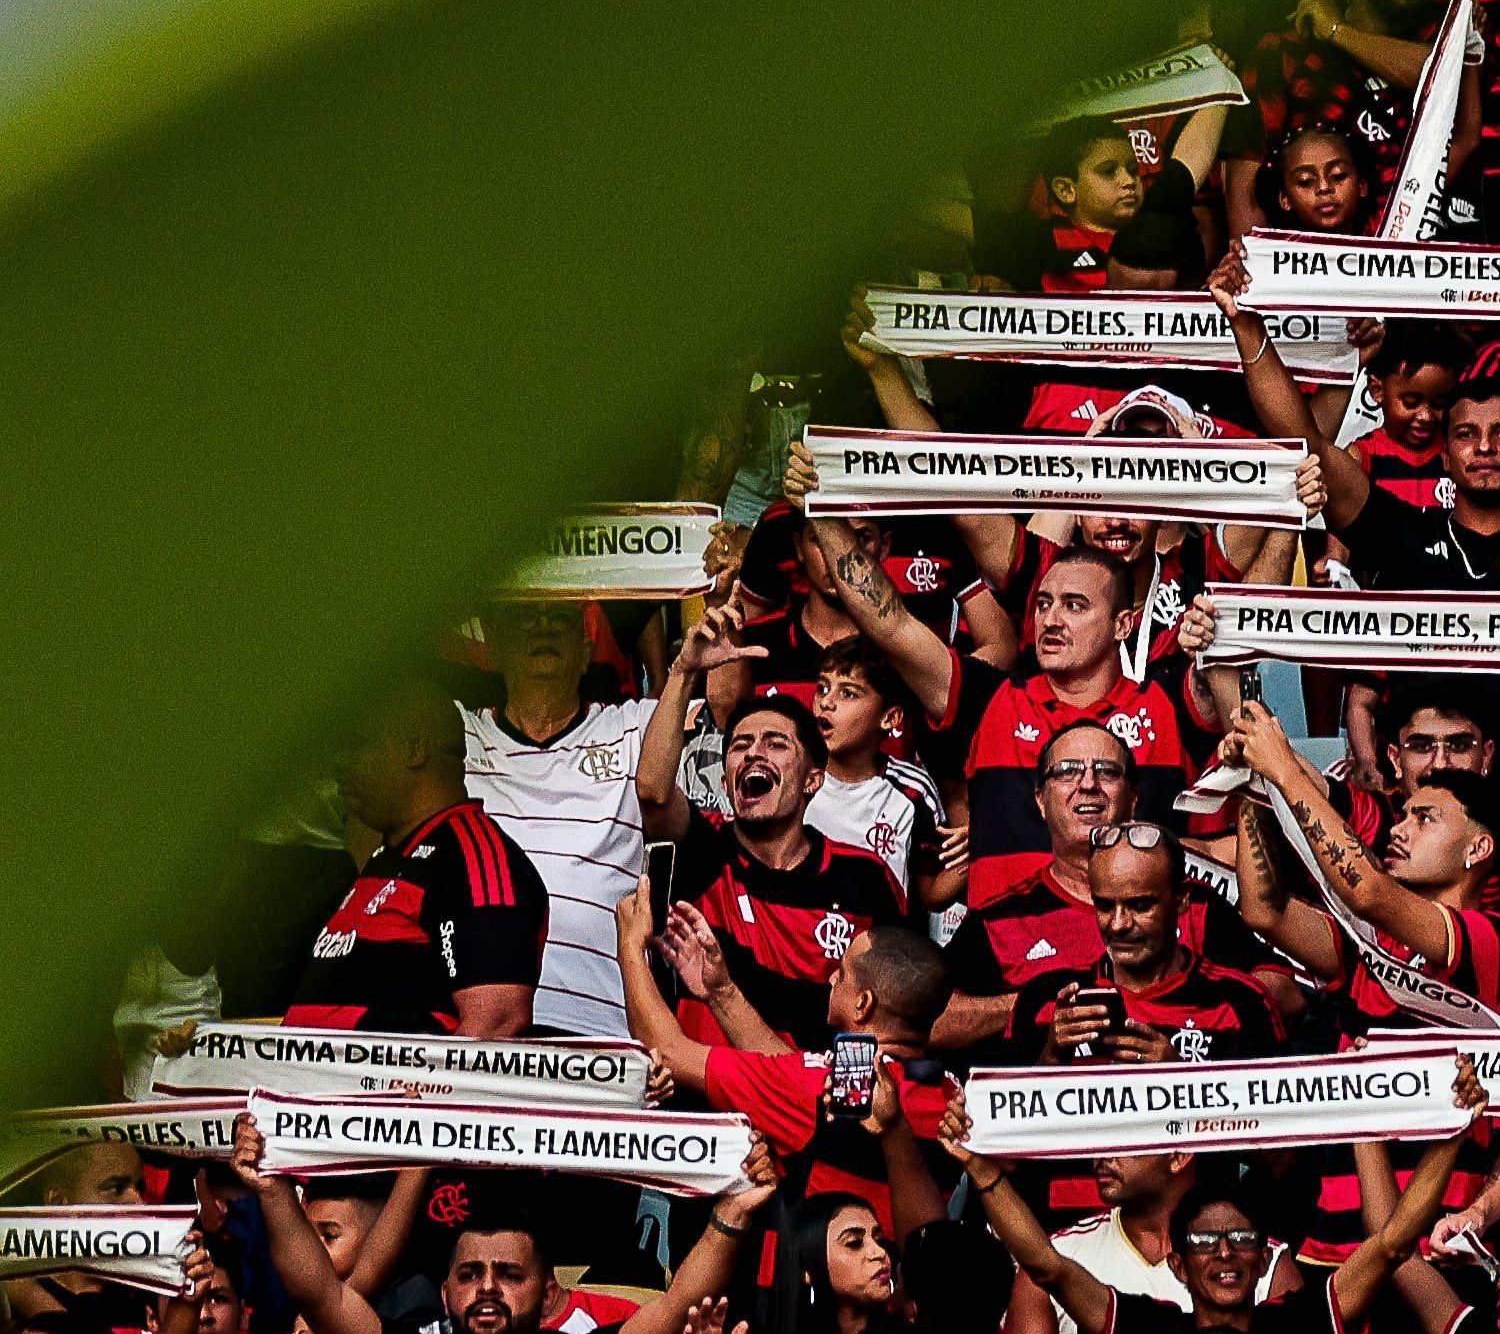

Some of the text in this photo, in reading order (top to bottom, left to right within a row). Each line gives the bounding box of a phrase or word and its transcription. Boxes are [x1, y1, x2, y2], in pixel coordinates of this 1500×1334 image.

[1451, 197, 1475, 213] NIKE
[1274, 251, 1328, 275] PRA
[1337, 253, 1415, 277] CIMA
[990, 1071, 1430, 1120] PRA CIMA DELES, FLAMENGO!
[1195, 1119, 1259, 1132] Betano
